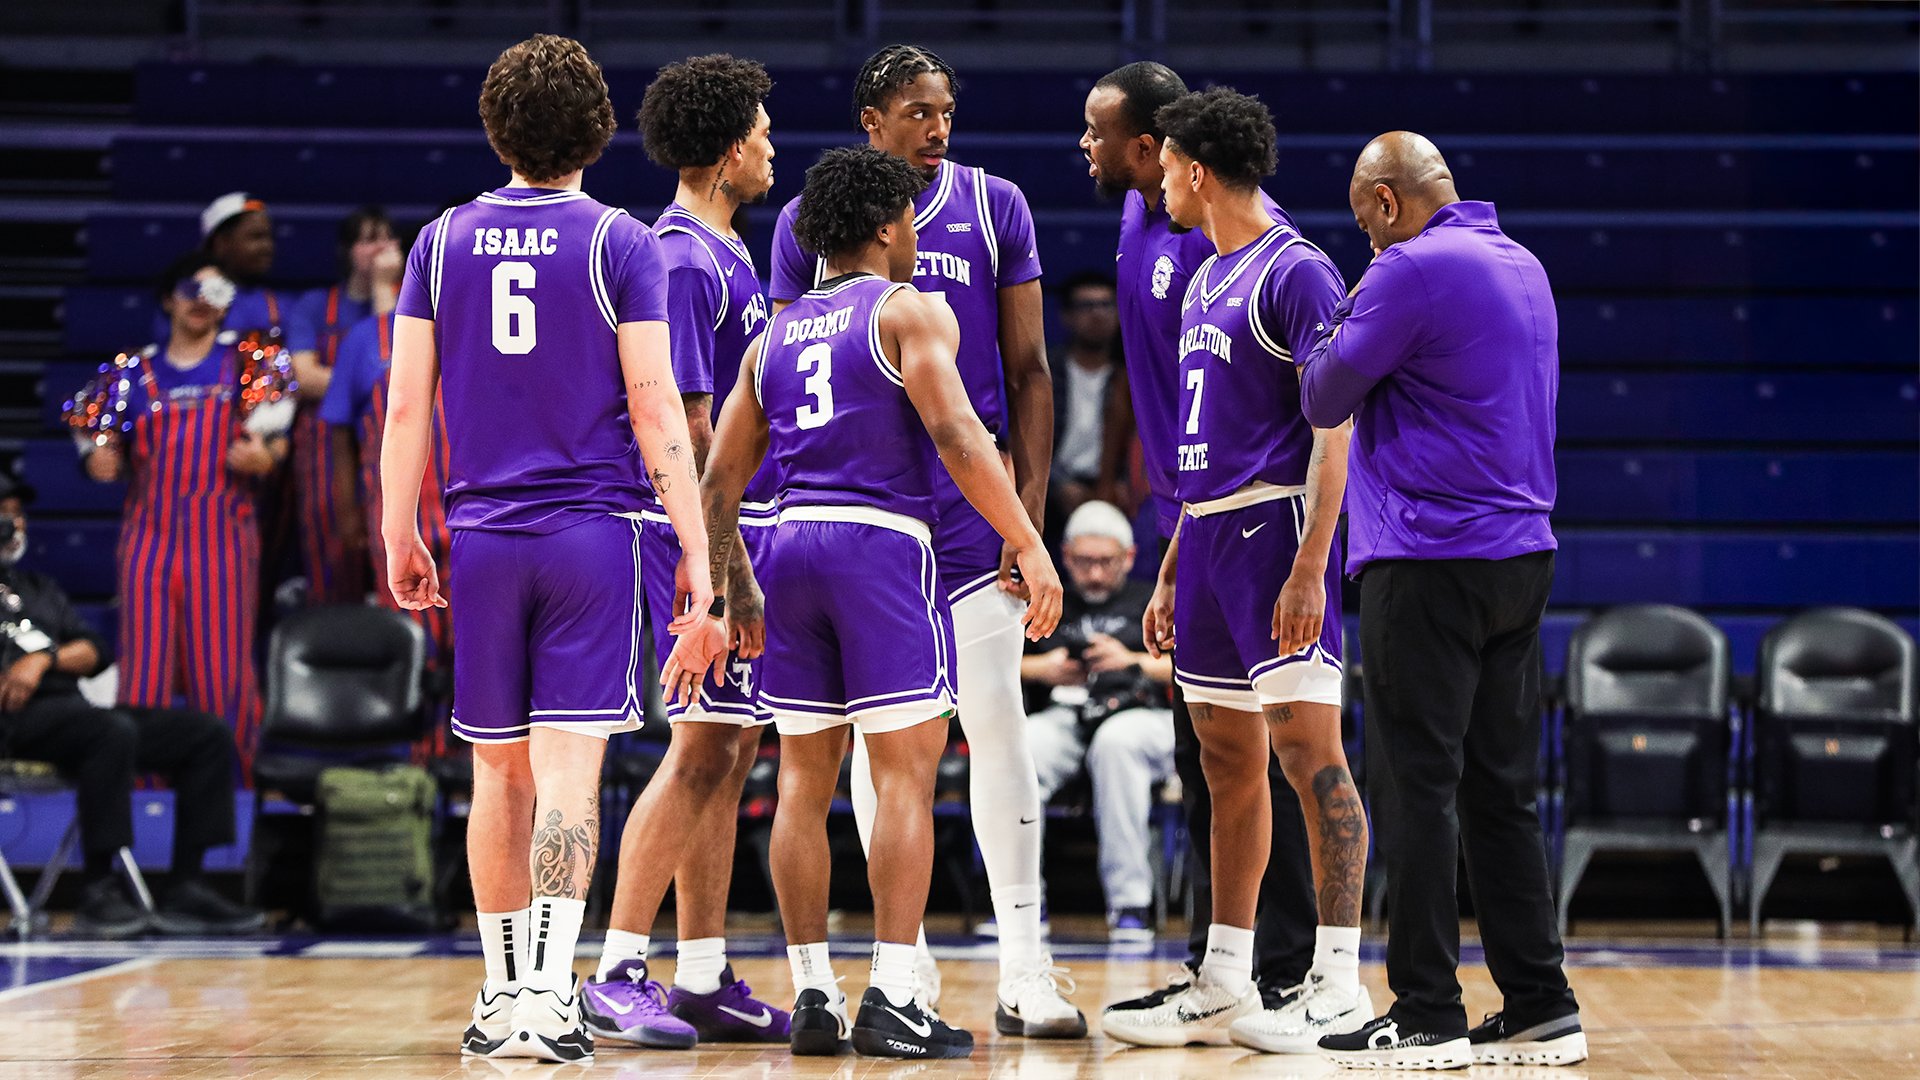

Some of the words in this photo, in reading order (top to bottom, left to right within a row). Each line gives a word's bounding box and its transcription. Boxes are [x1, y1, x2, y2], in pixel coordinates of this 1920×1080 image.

[472, 227, 559, 256] ISAAC
[491, 260, 537, 355] 6
[782, 305, 855, 347] DORMU
[795, 342, 835, 431] 3
[1185, 368, 1205, 435] 7
[1177, 442, 1209, 472] TATE
